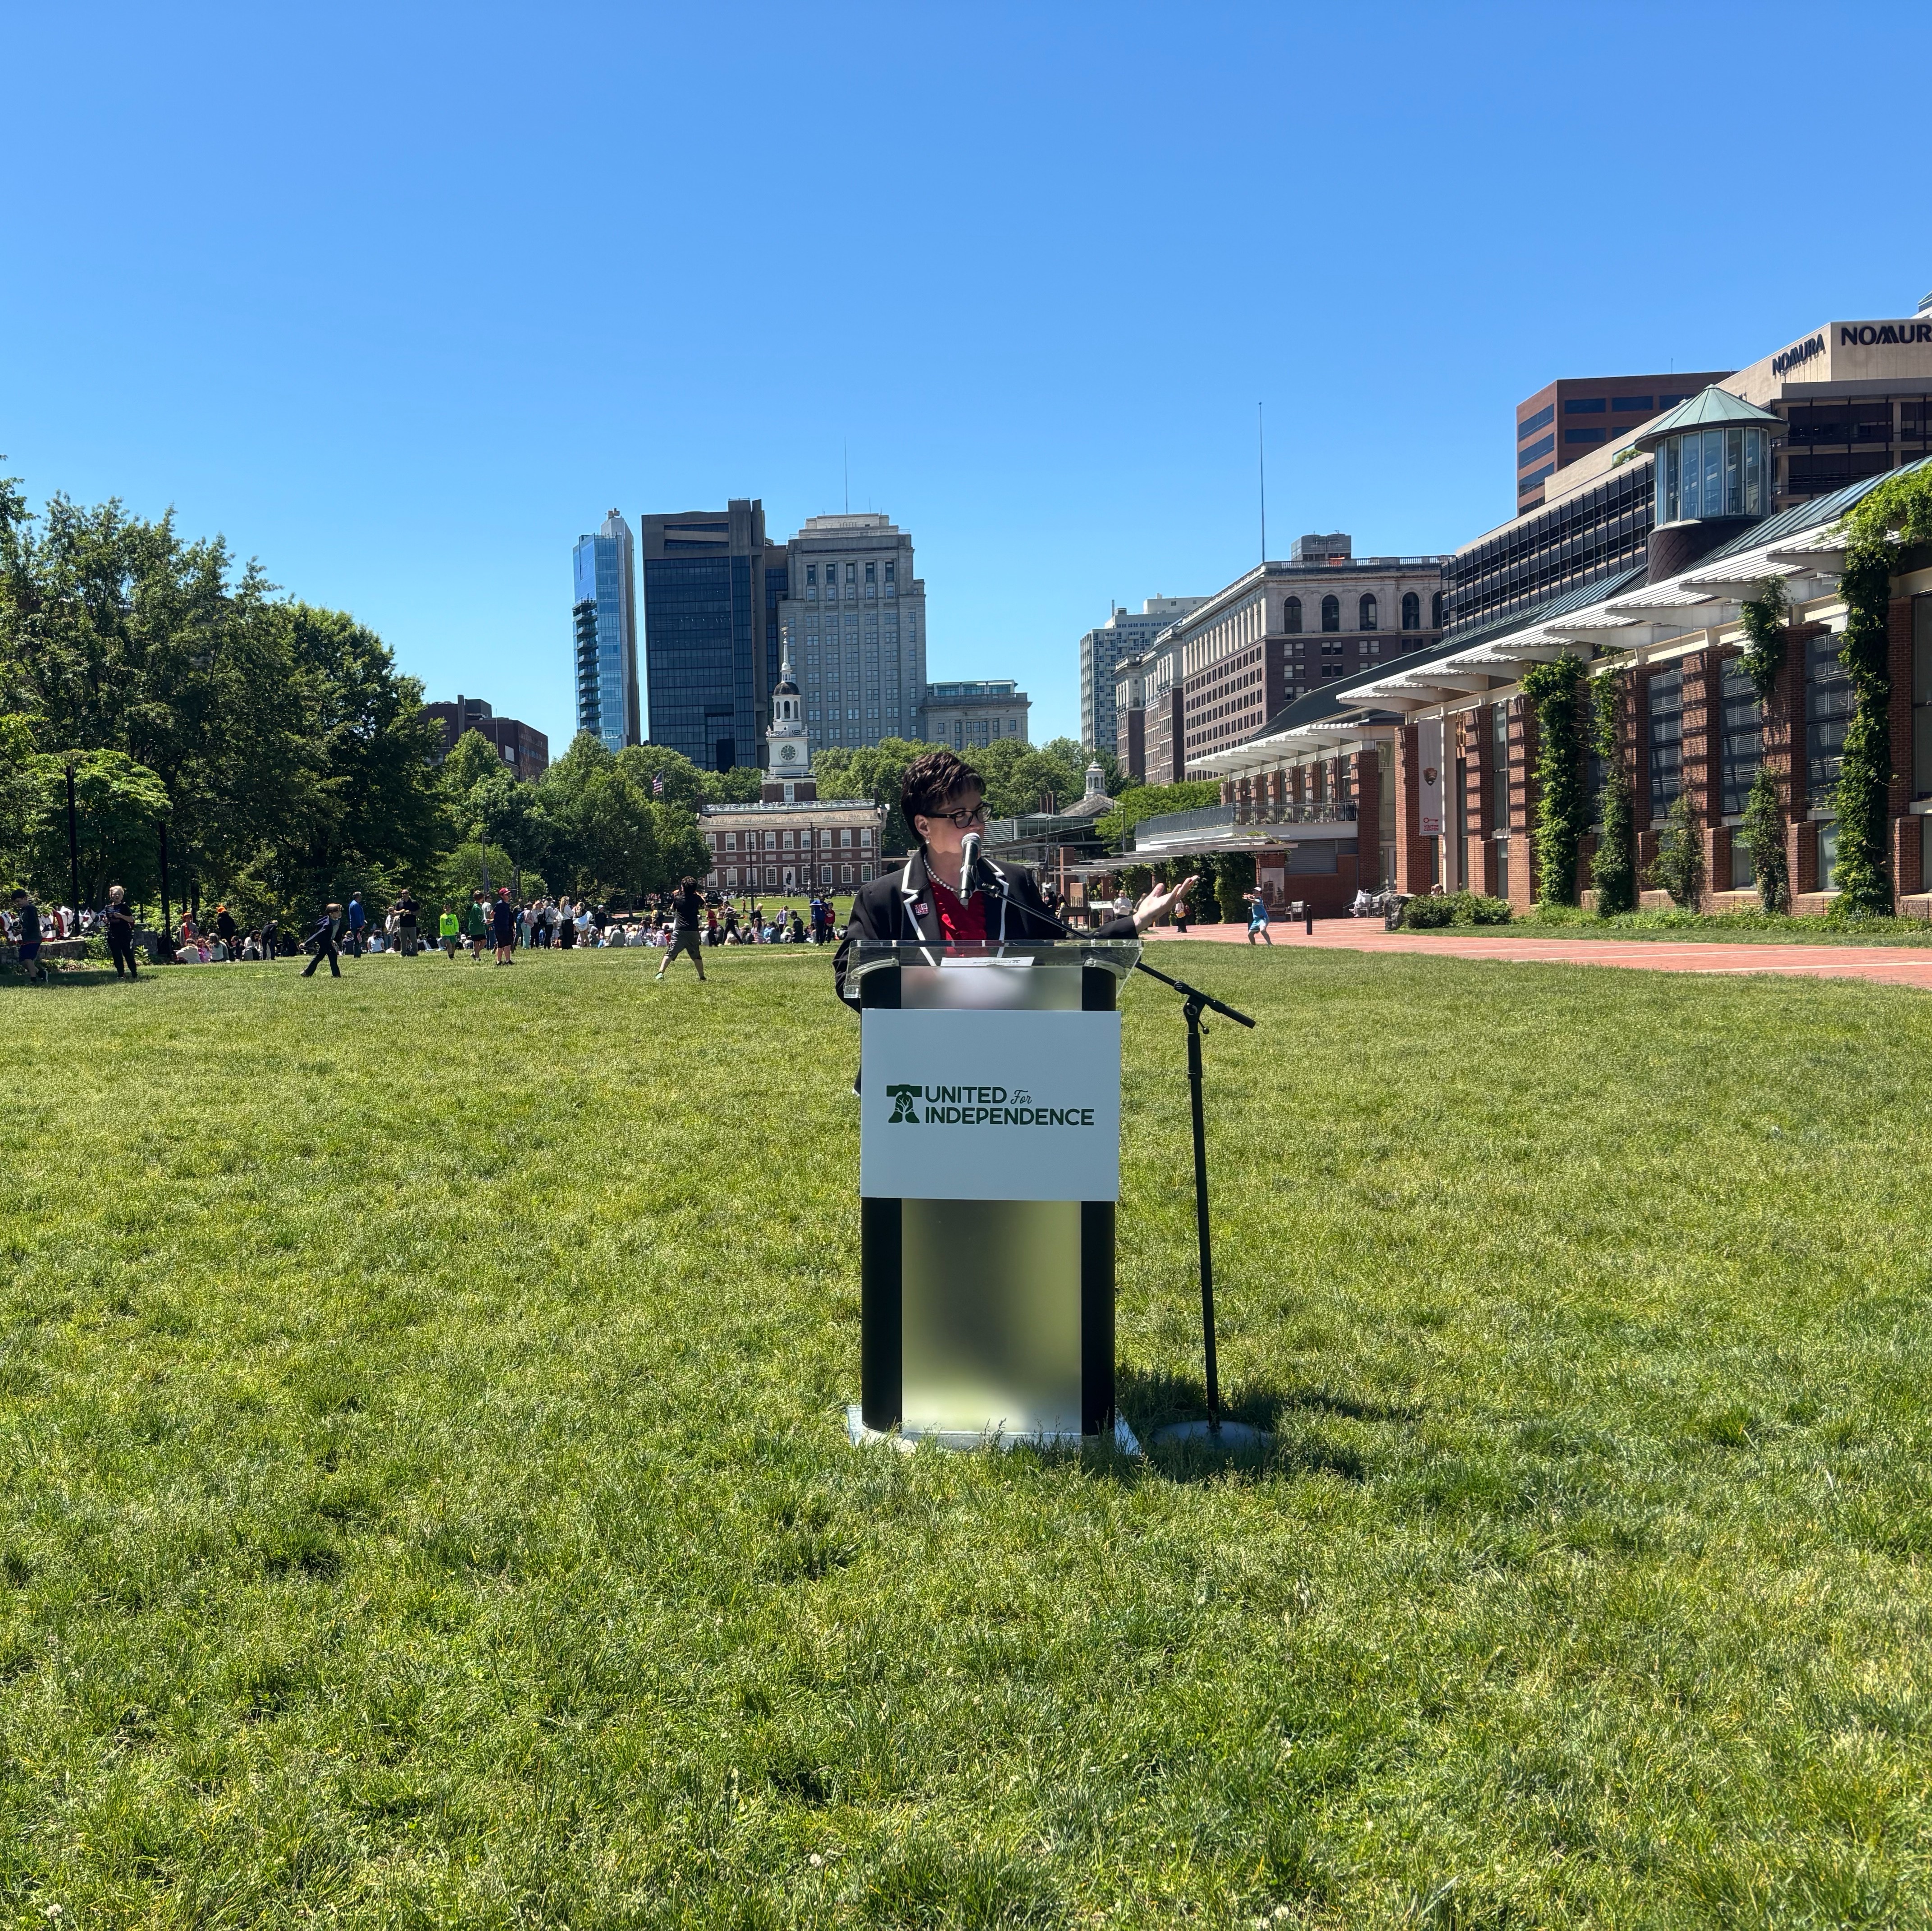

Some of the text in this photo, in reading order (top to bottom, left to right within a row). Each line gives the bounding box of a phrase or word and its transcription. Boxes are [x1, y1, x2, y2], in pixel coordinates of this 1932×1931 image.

[1772, 334, 1825, 375] NOMURA
[925, 1086, 1032, 1104] UNITED For
[925, 1107, 1094, 1126] INDEPENDENCE
